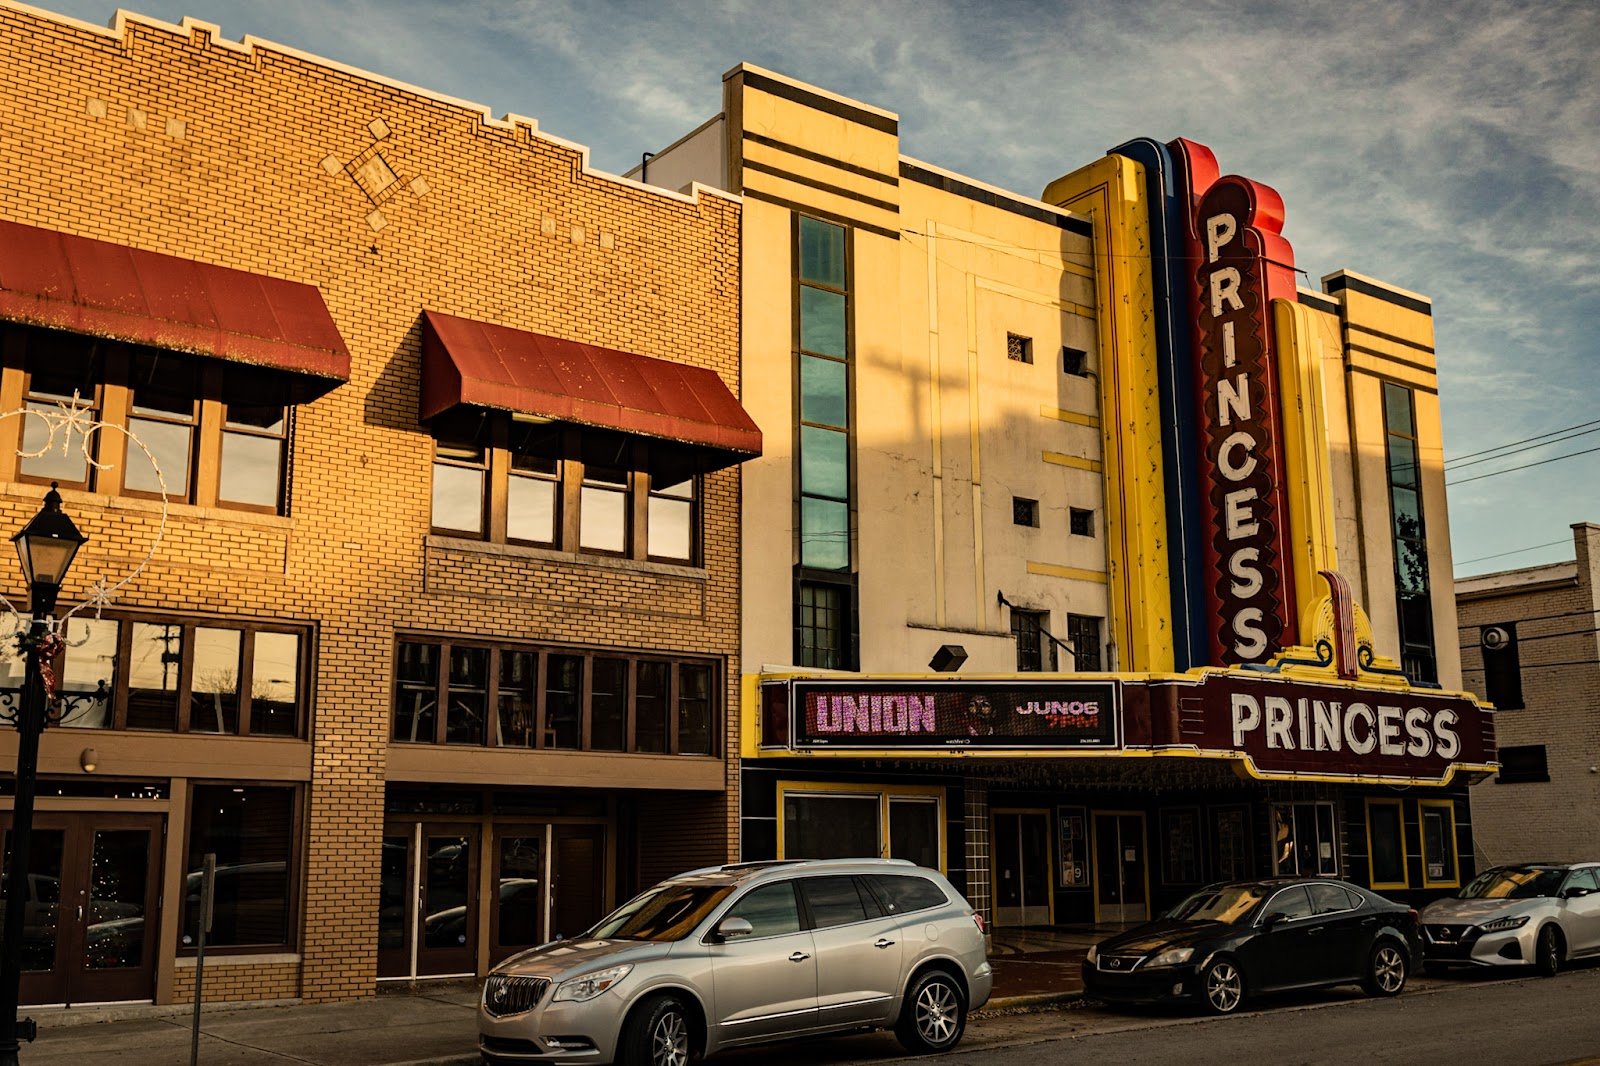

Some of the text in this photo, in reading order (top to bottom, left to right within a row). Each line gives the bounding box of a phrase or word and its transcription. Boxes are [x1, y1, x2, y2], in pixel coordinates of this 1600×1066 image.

[1206, 213, 1267, 659] PRINCESS
[816, 695, 936, 732] UNION
[1231, 693, 1461, 759] PRINCESS
